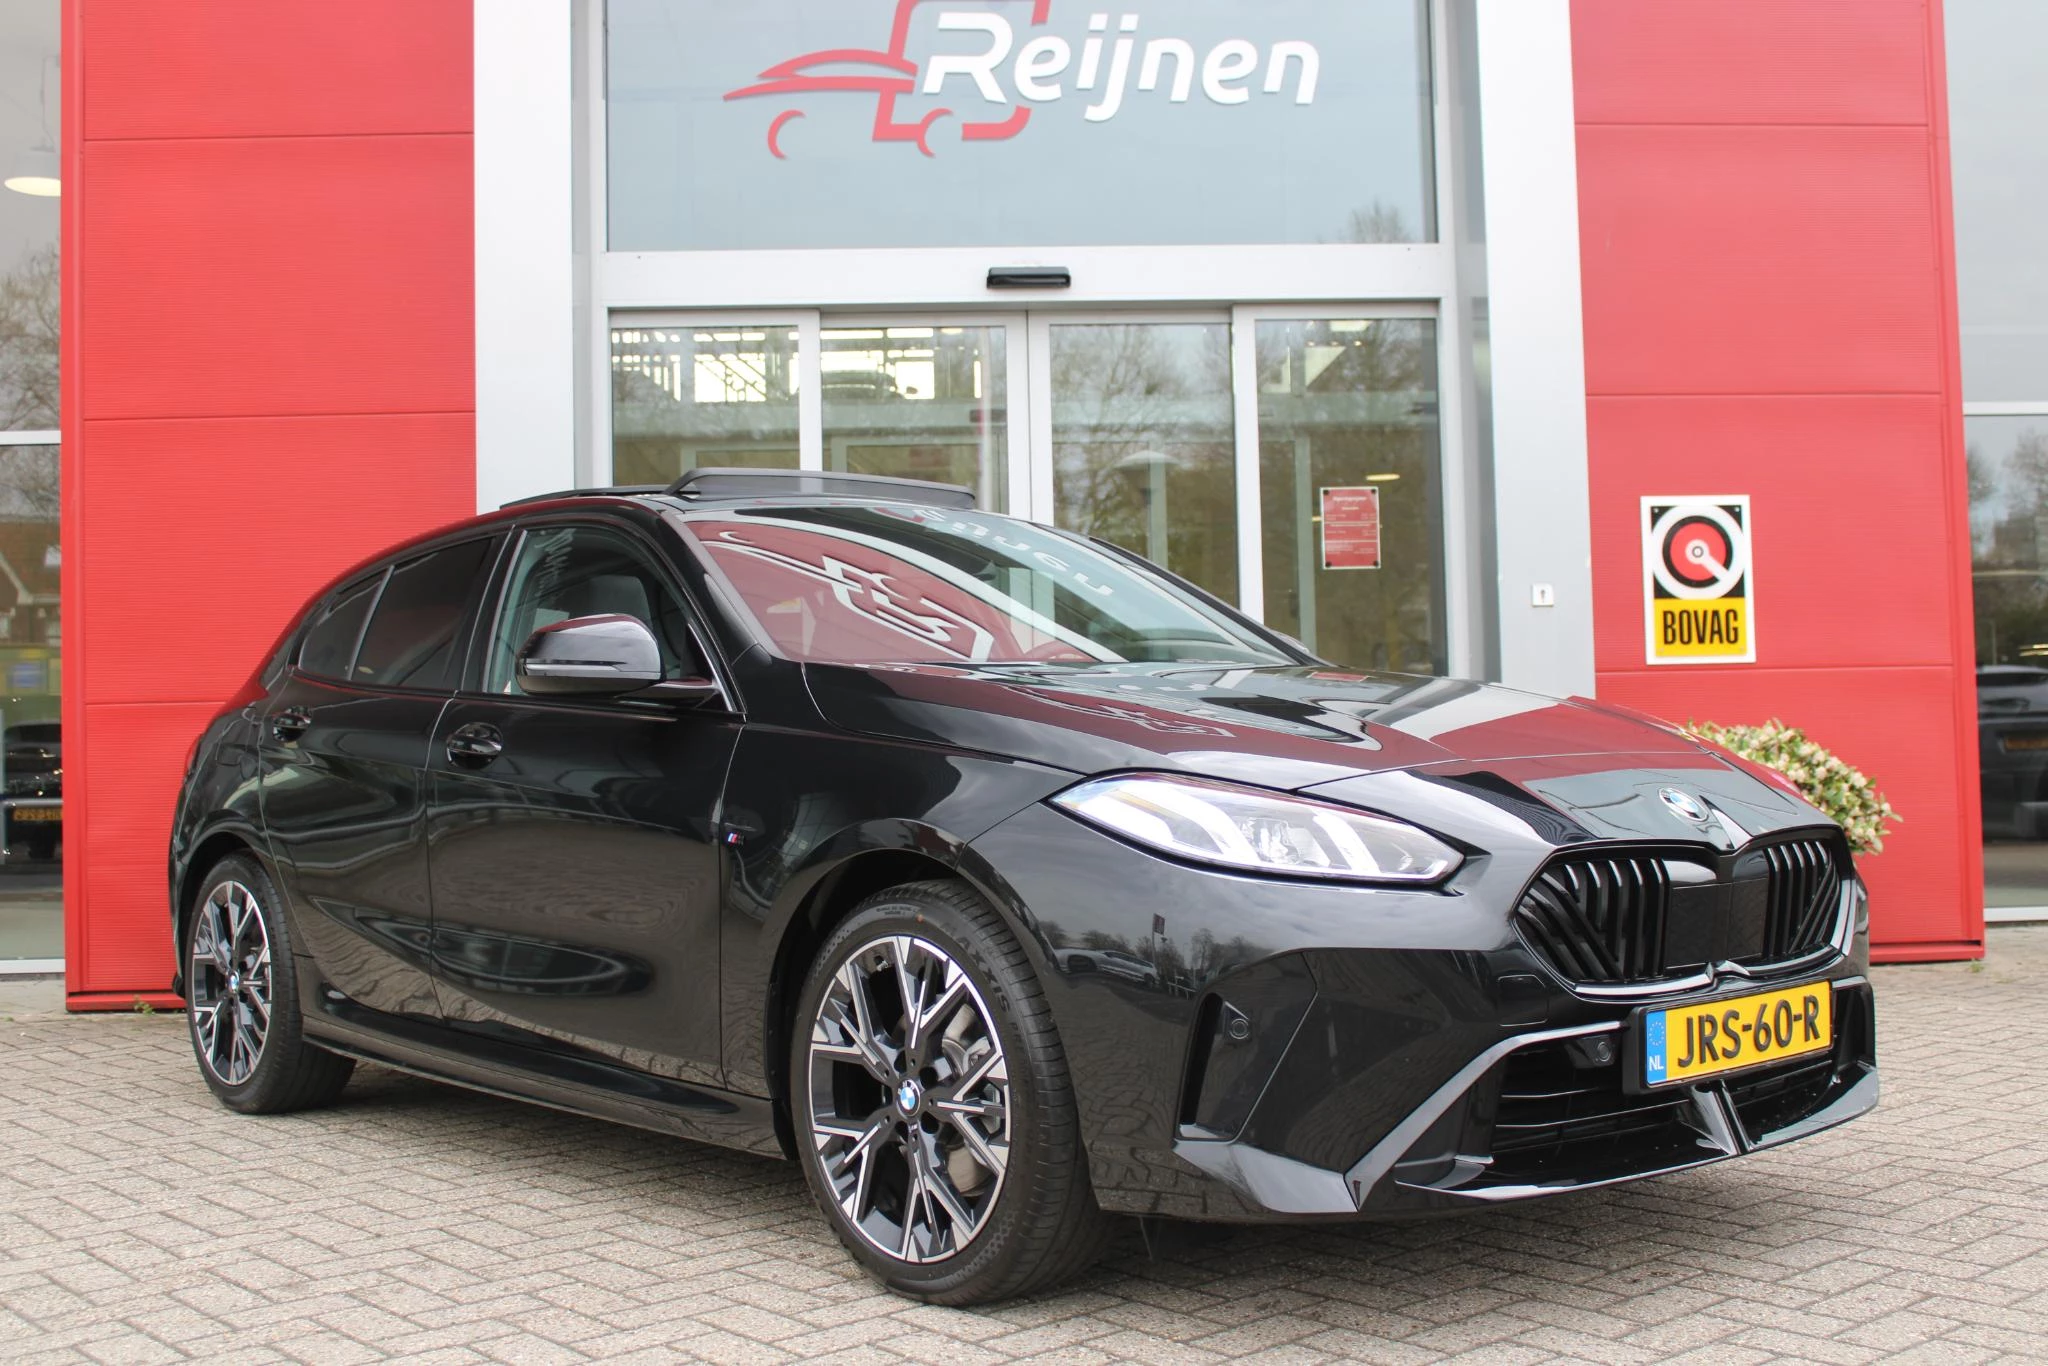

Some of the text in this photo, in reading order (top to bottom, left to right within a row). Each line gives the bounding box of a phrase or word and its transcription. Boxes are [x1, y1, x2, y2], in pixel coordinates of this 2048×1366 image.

[922, 12, 1320, 122] Reijnen
[1663, 609, 1739, 645] BOVAG
[1678, 995, 1820, 1068] JRS-60-R
[1649, 1056, 1664, 1070] NL
